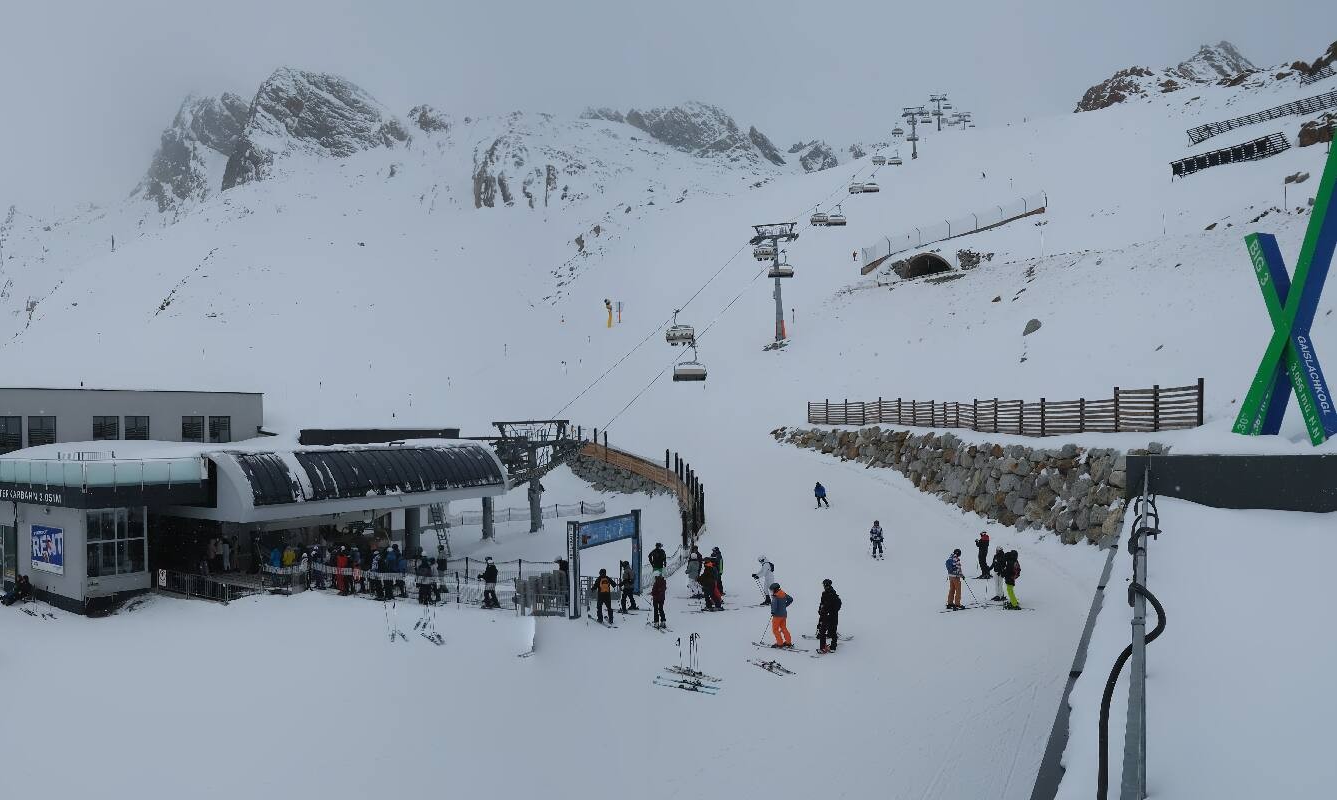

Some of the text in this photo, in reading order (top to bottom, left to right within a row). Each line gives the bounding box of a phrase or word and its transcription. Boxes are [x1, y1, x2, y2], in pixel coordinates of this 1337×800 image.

[1250, 239, 1269, 286] BIG 3
[1297, 335, 1331, 416] GAISLACHKOGL
